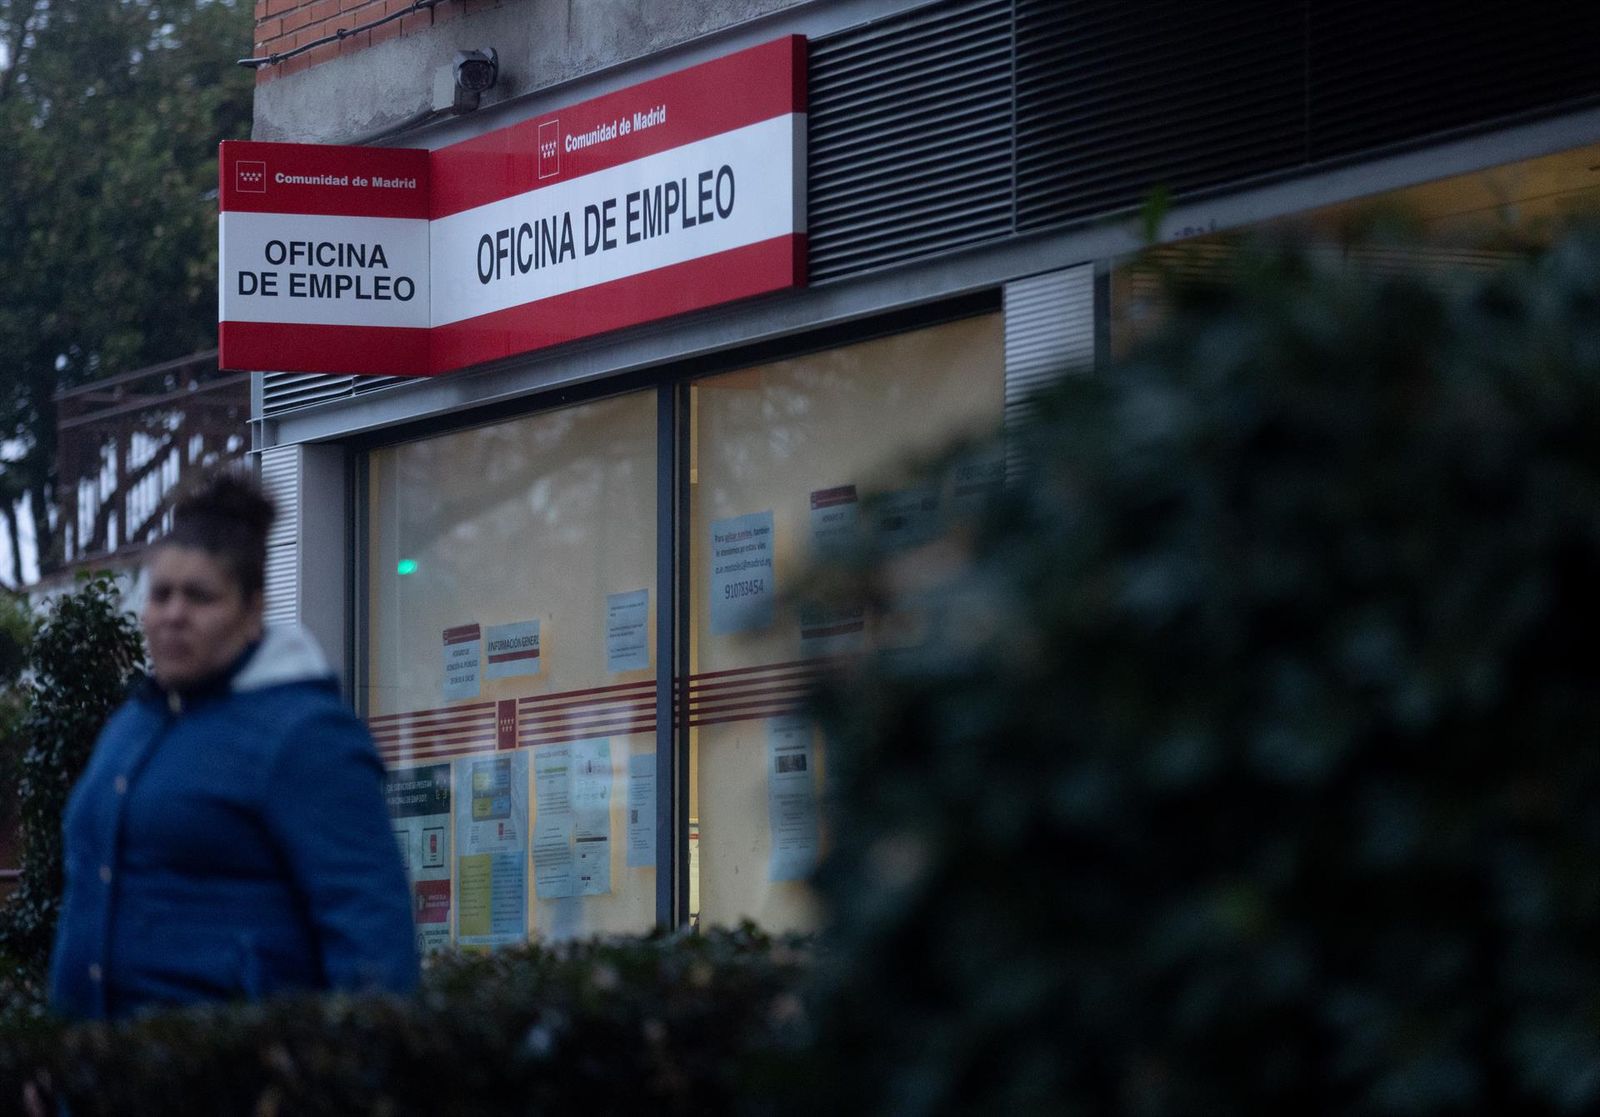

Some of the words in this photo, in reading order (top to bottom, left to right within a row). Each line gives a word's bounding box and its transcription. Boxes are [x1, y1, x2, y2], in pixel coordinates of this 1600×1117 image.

[564, 119, 617, 153] Comunidad
[619, 116, 631, 137] de
[633, 103, 667, 132] Madrid
[275, 172, 348, 186] Comunidad
[352, 176, 368, 187] de
[372, 177, 416, 189] Madrid
[477, 211, 576, 285] OFICINA
[584, 198, 617, 256] DE
[626, 165, 735, 244] EMPLEO
[264, 240, 389, 269] OFICINA
[238, 271, 279, 297] DE
[289, 272, 416, 302] EMPLEO
